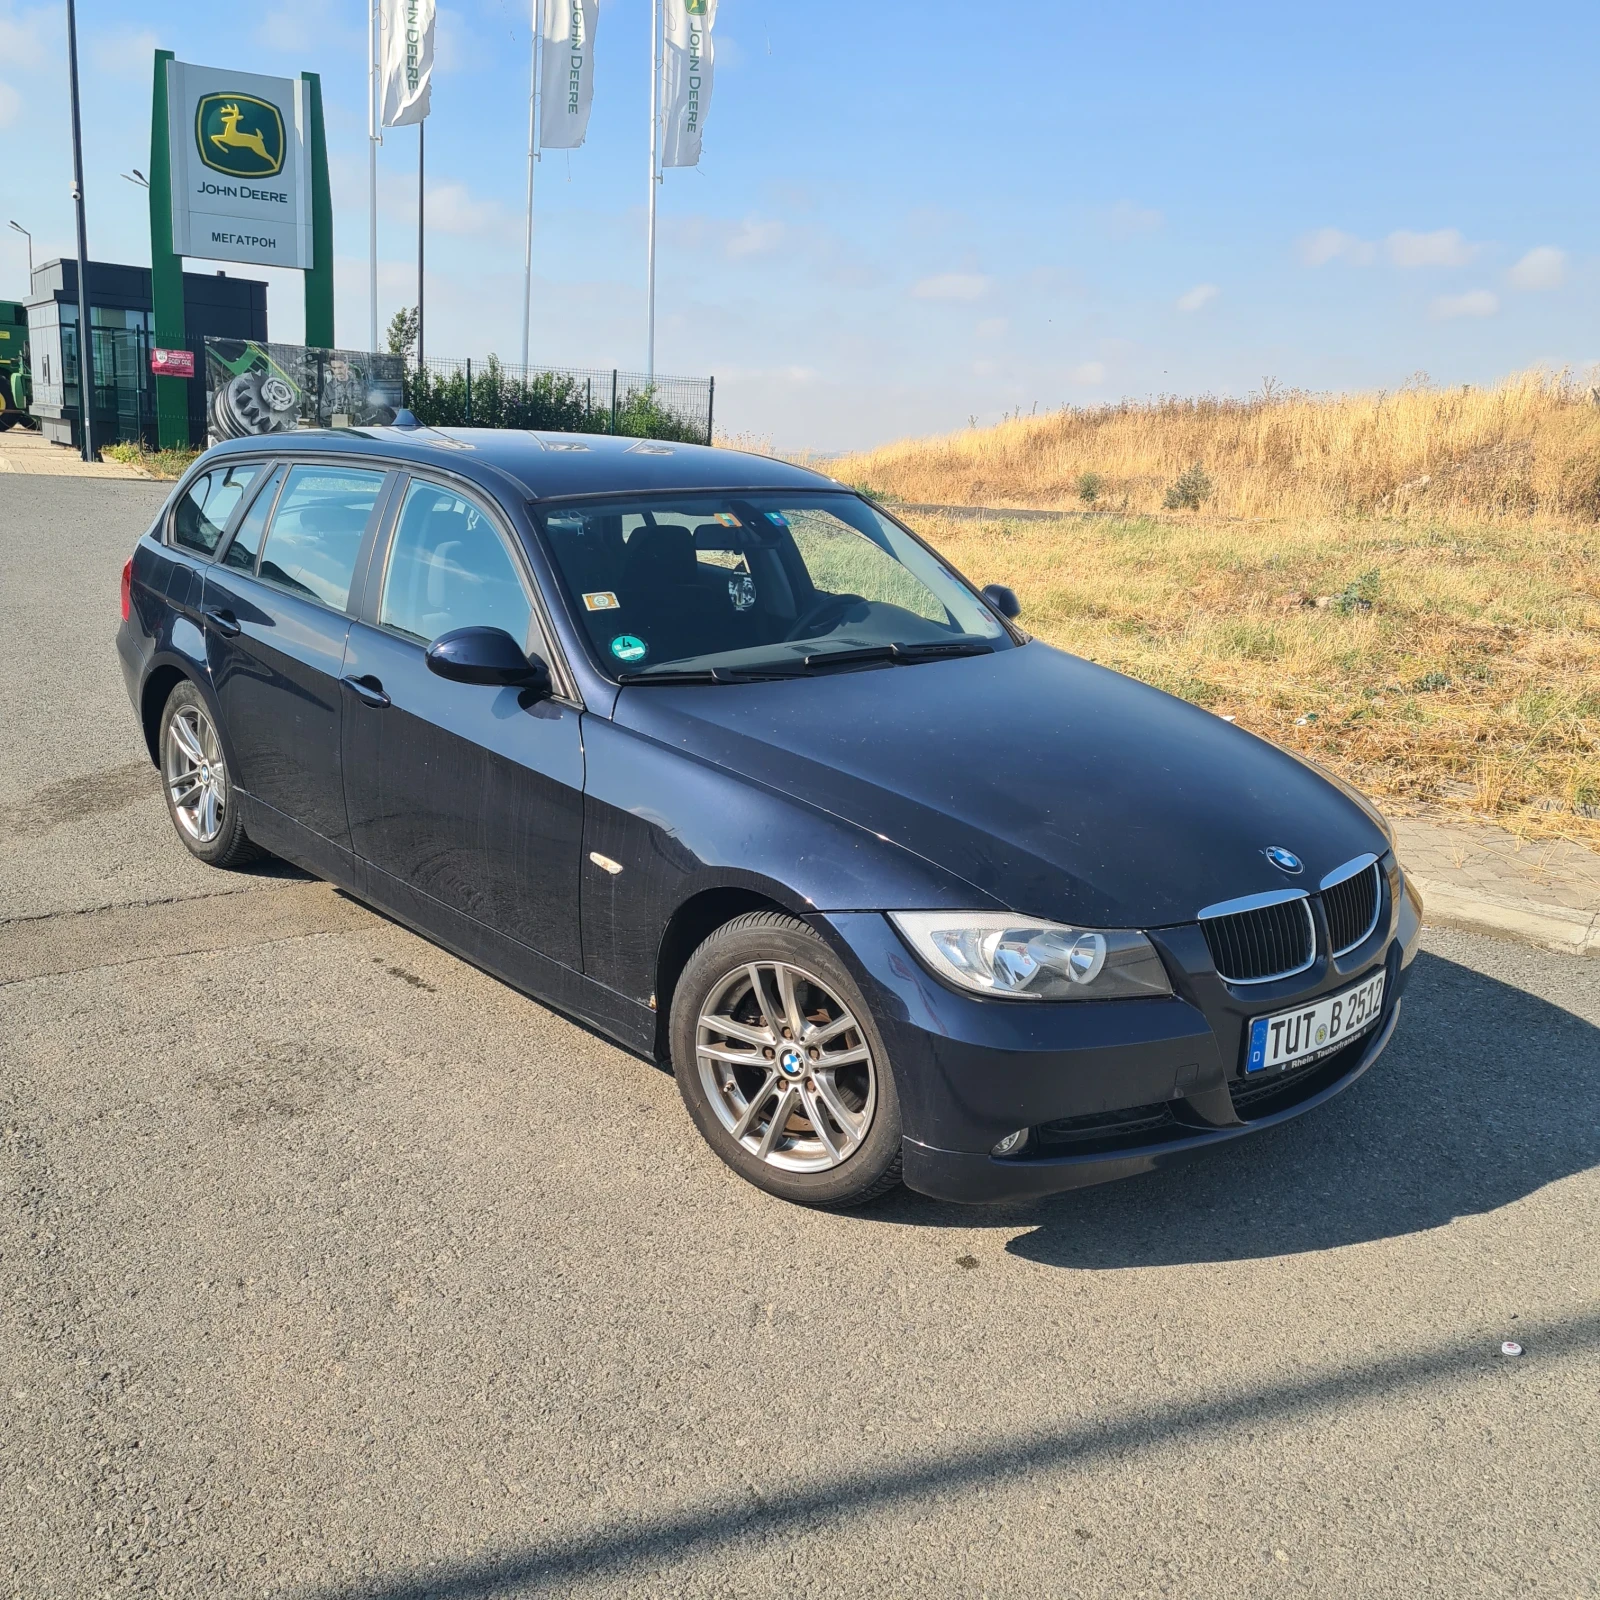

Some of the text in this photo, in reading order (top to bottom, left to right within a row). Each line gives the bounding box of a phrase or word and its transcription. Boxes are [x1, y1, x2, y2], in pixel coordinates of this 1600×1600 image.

[407, 0, 420, 91] HN DEERE
[568, 1, 583, 115] JOHN DEERE
[687, 22, 702, 133] JOHN DEERE
[197, 181, 288, 204] JOHN DEERE
[211, 232, 276, 248] МЕГАТРОН
[622, 637, 632, 648] 4
[1270, 977, 1384, 1059] TUT B 2512
[1252, 1051, 1261, 1063] D
[1291, 1055, 1314, 1068] Rhein
